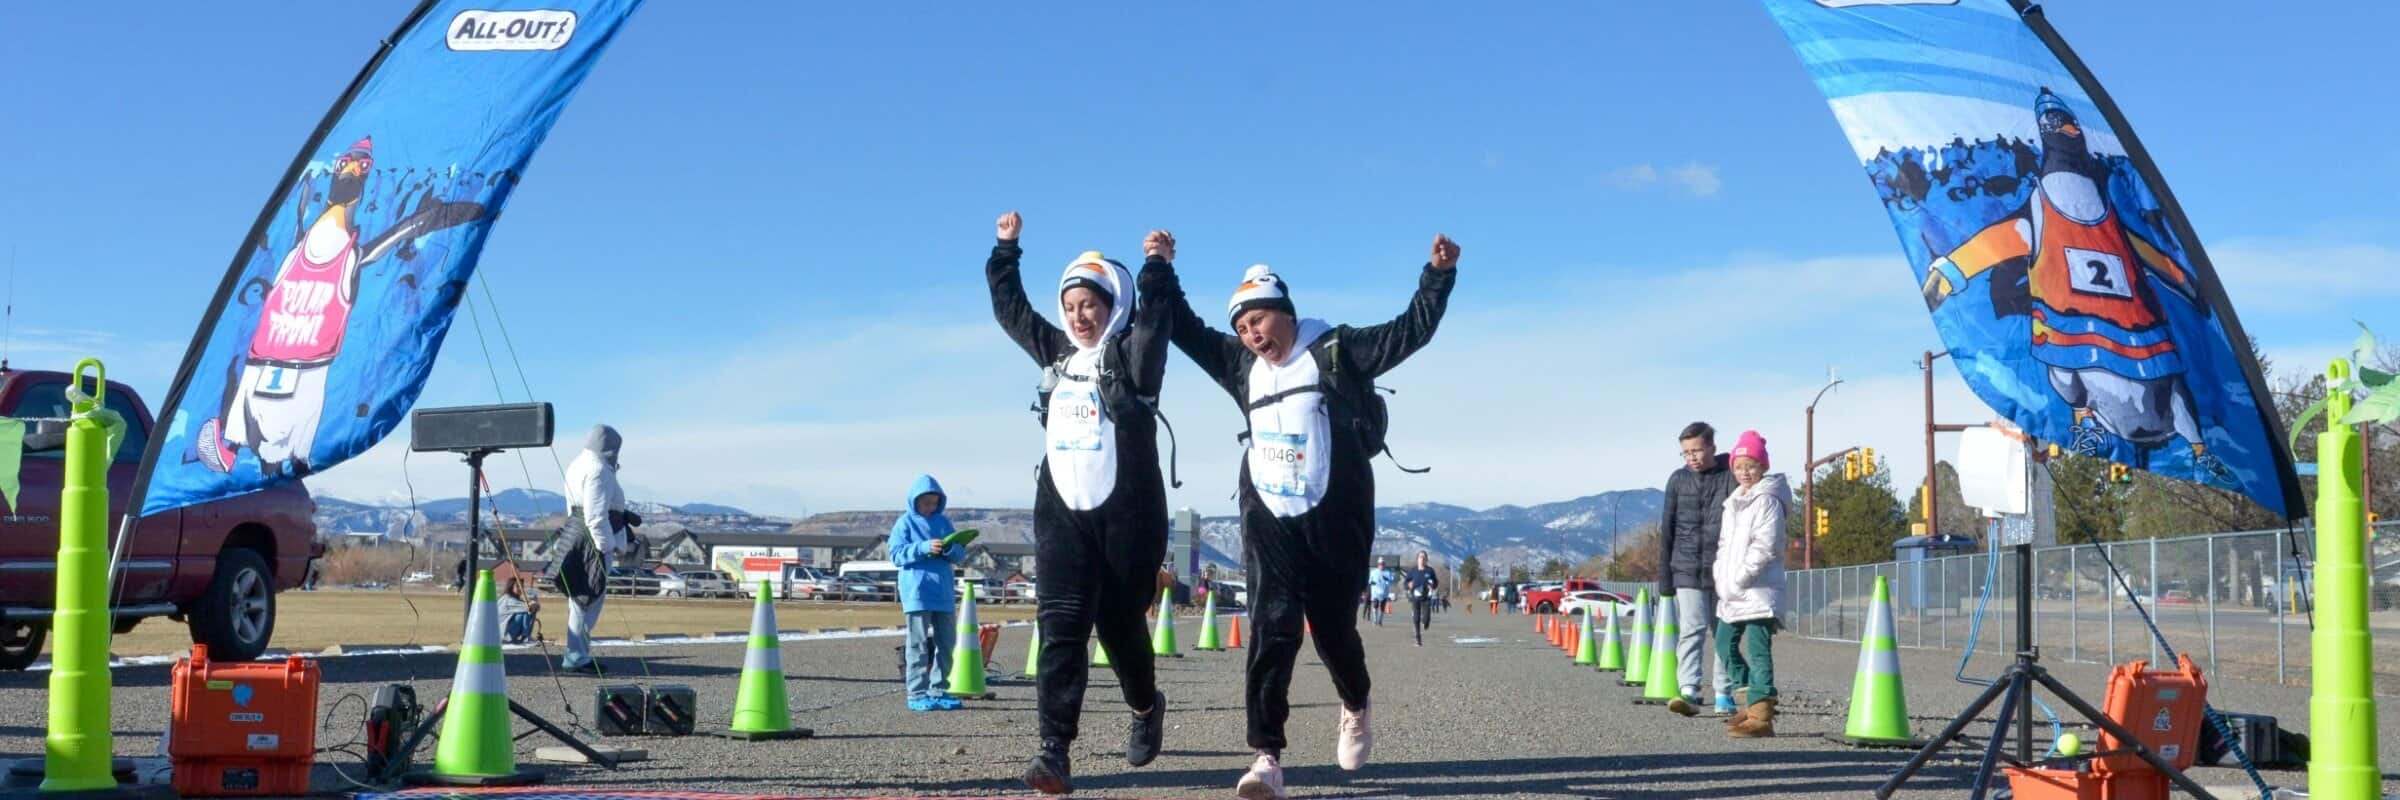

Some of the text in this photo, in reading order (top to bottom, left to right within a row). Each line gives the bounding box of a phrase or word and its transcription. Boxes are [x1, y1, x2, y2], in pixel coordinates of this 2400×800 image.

[2086, 260, 2114, 290] 2
[281, 280, 335, 315] POLAR
[267, 311, 325, 346] PROWL
[266, 368, 284, 390] 1
[1059, 405, 1089, 419] 1040
[1262, 447, 1296, 463] 1046
